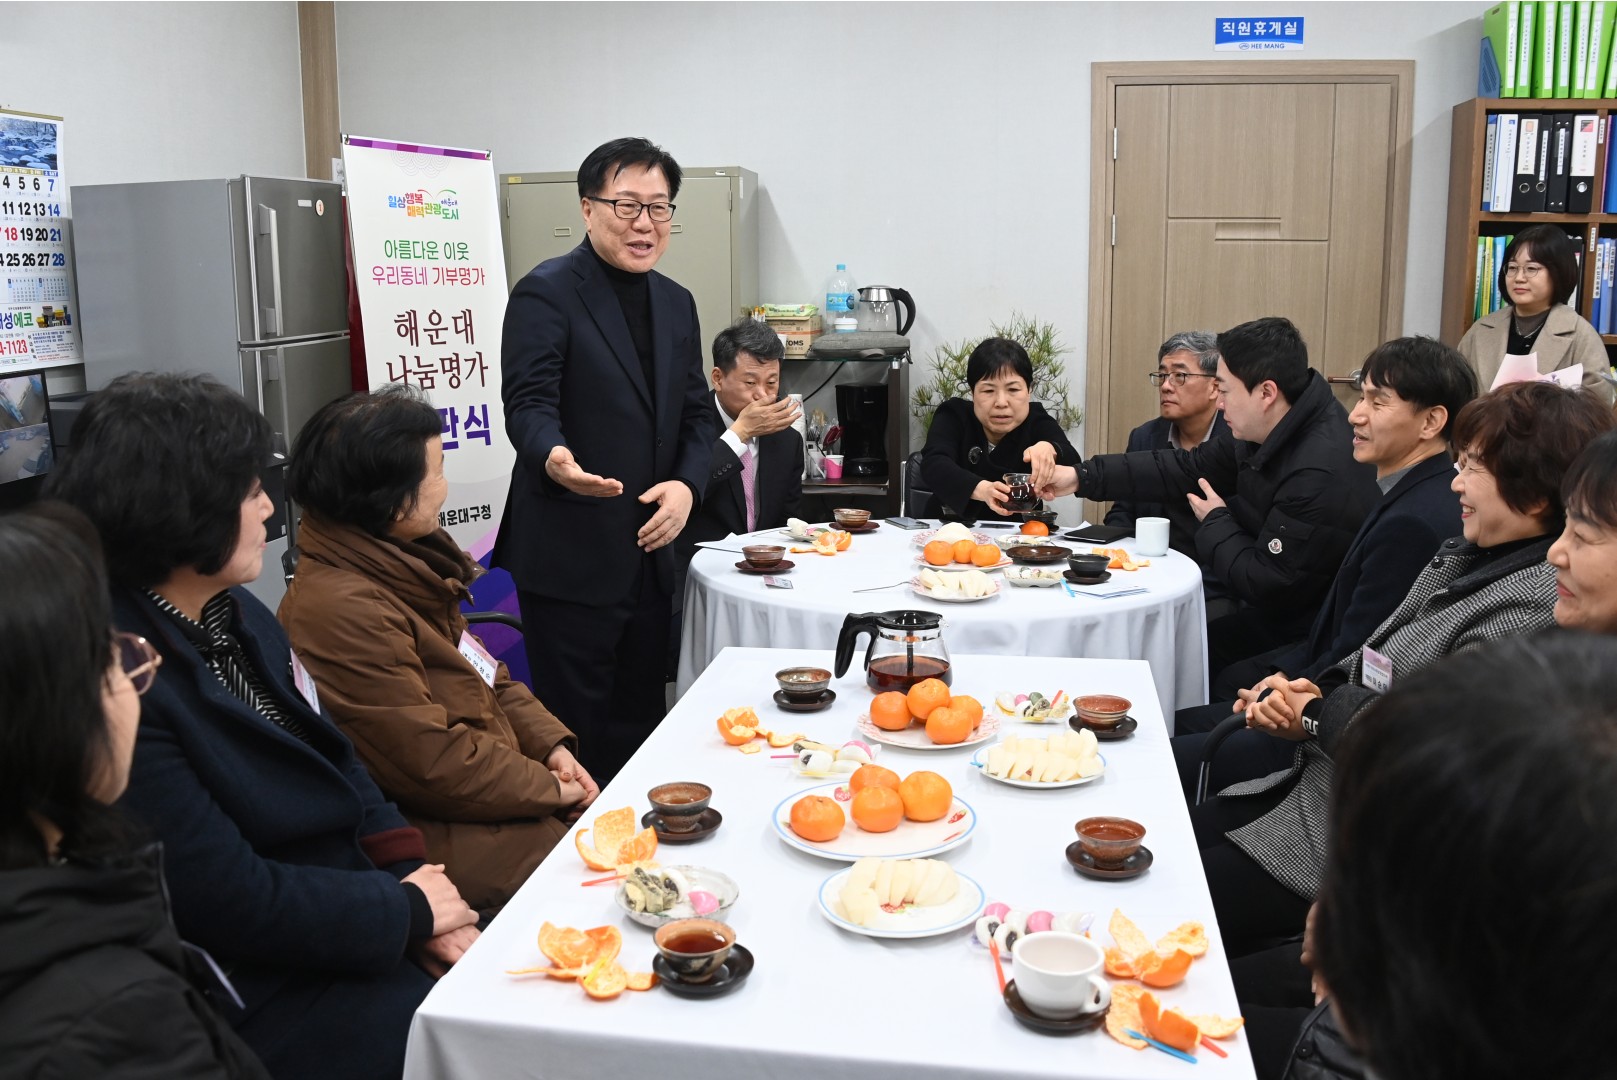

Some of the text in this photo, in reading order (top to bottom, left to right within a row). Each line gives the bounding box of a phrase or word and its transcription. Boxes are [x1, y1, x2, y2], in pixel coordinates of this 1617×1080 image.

[1222, 21, 1297, 36] 직원휴게실
[3, 175, 55, 191] 4 5 6 7
[2, 201, 60, 217] 11 12 13 14
[5, 227, 62, 241] 18 19 20 21
[384, 240, 470, 261] 아름다운 이웃
[6, 253, 20, 267] 25
[22, 253, 36, 267] 26
[37, 253, 50, 267] 27
[52, 253, 66, 267] 28
[372, 265, 486, 286] 우리동네 기부명가
[393, 308, 475, 348] 해운대
[386, 351, 489, 391] 나눔명가
[436, 404, 491, 451] 판식
